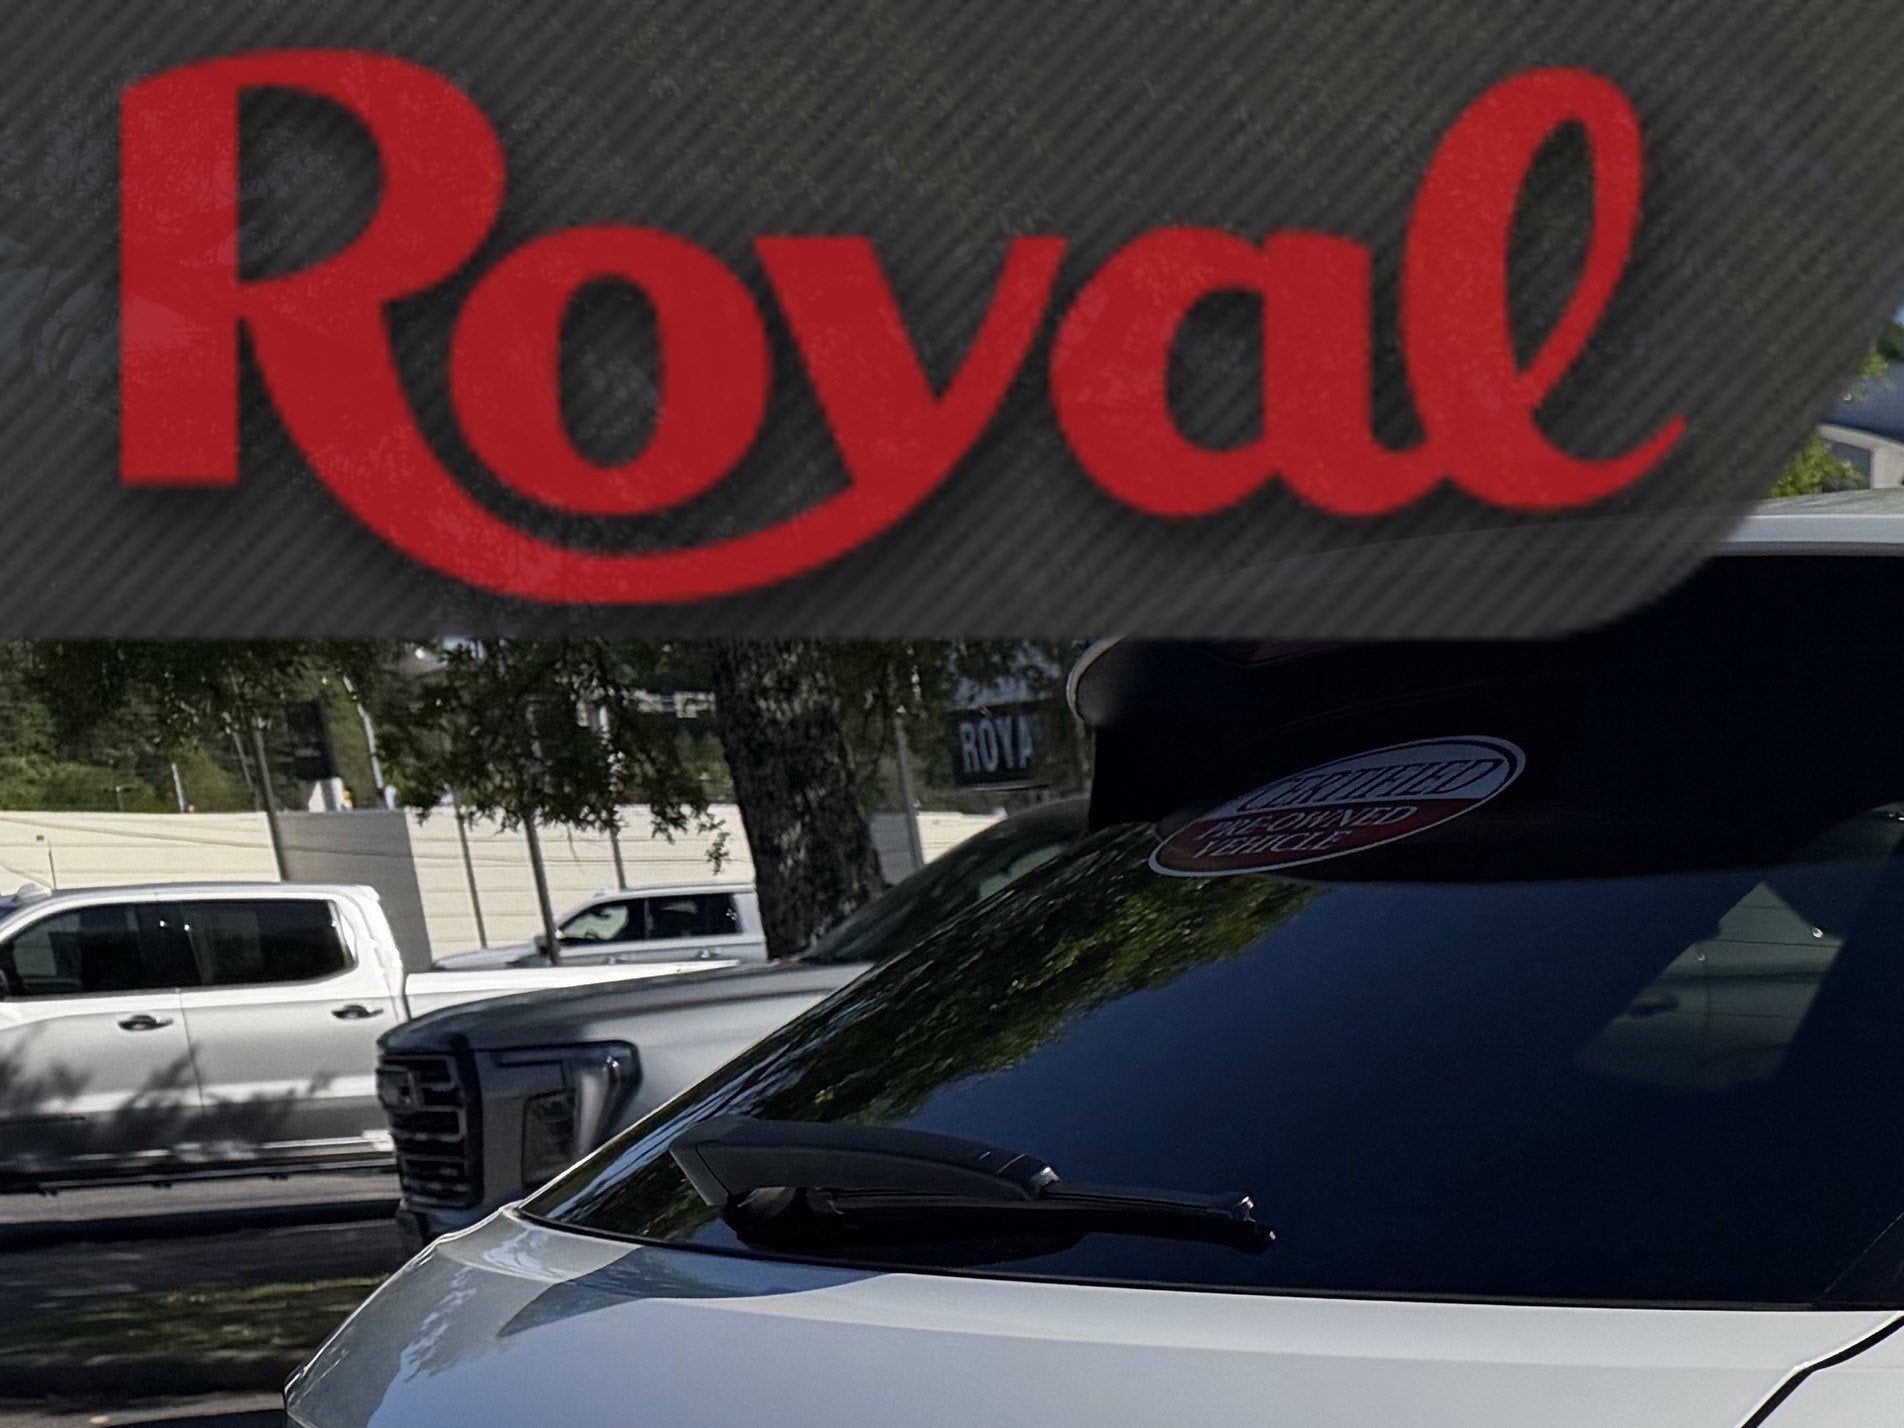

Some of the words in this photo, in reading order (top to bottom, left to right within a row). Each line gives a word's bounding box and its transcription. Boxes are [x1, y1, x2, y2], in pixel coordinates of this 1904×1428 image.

[1236, 758, 1505, 812] CERTIFIED
[1194, 804, 1419, 841] PRE-OWNED
[1192, 828, 1353, 859] VEHICLE
